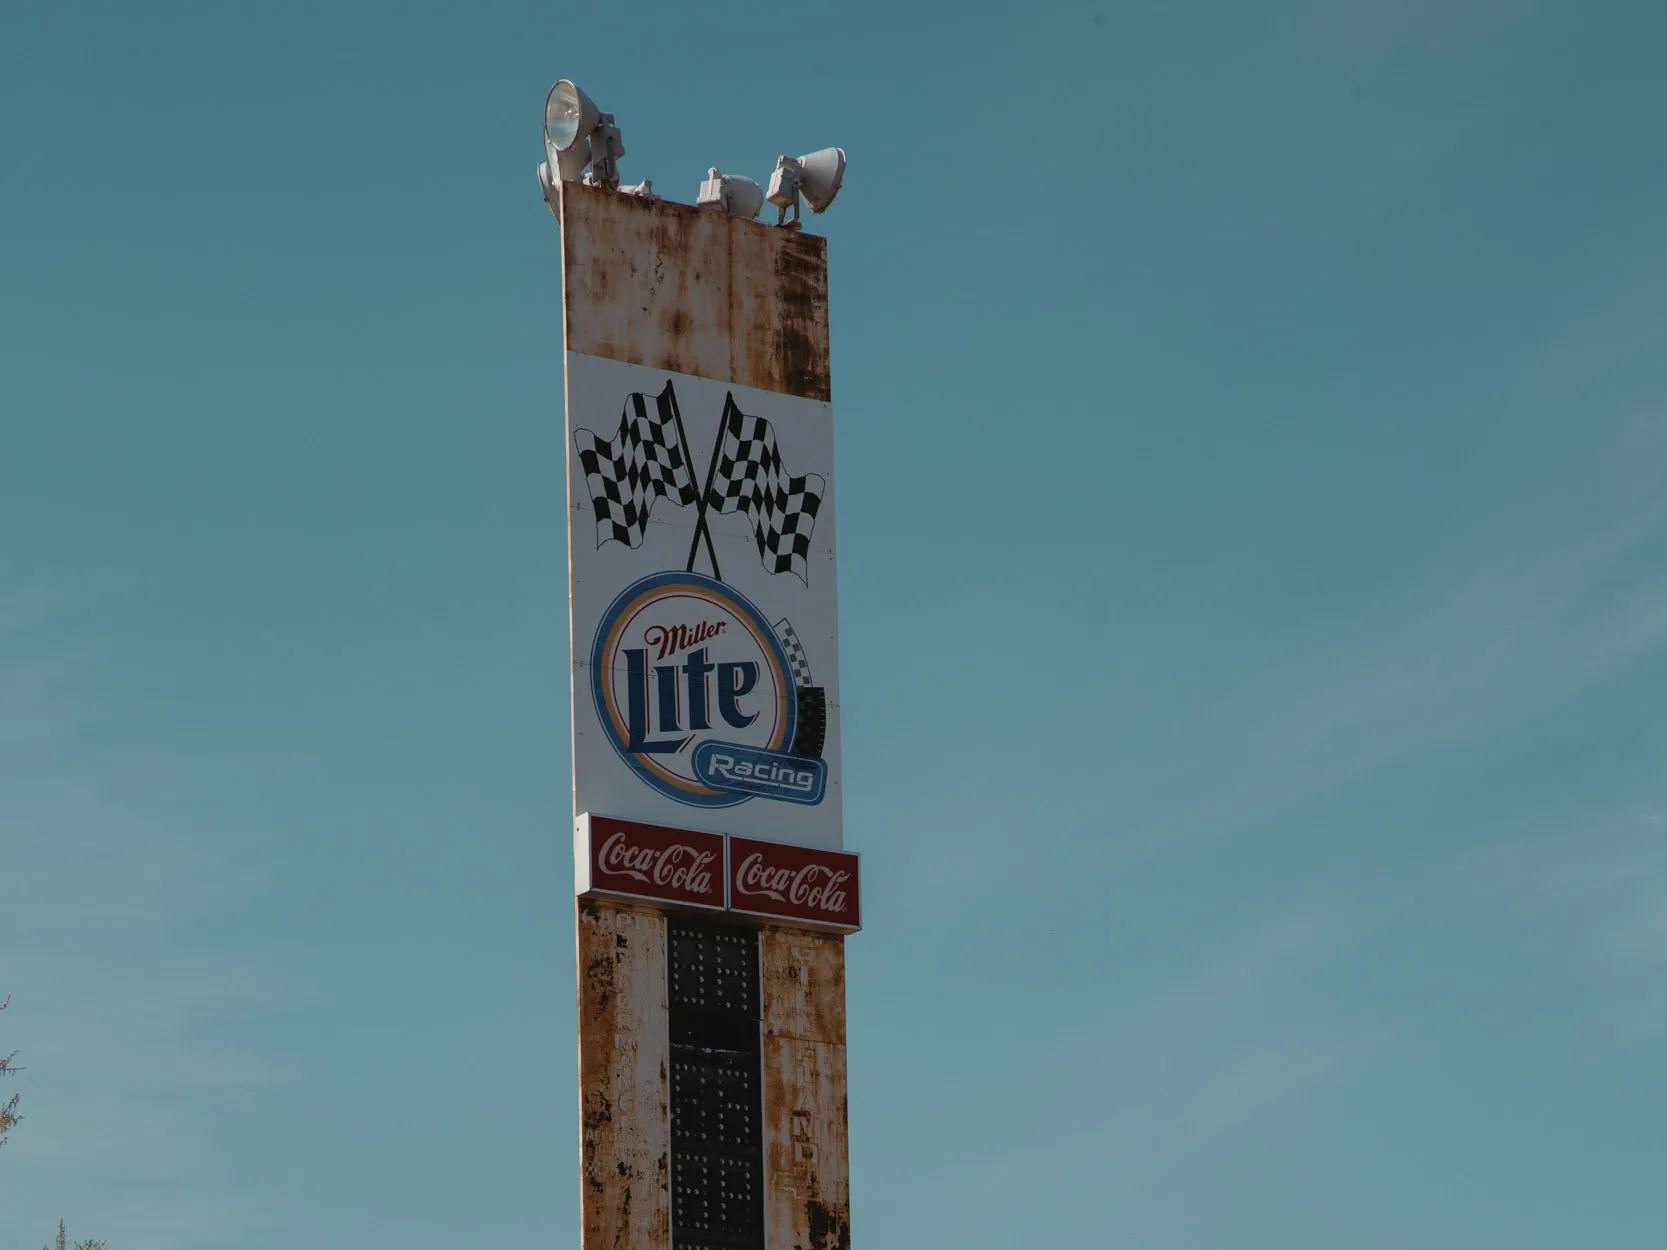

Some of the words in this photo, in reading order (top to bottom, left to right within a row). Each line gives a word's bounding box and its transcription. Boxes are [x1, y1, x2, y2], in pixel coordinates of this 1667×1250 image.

[644, 620, 726, 661] Miller
[621, 647, 760, 754] Lite
[708, 753, 814, 791] Racing
[599, 832, 716, 894] Coca-Cola
[736, 853, 850, 913] Coca-Cola
